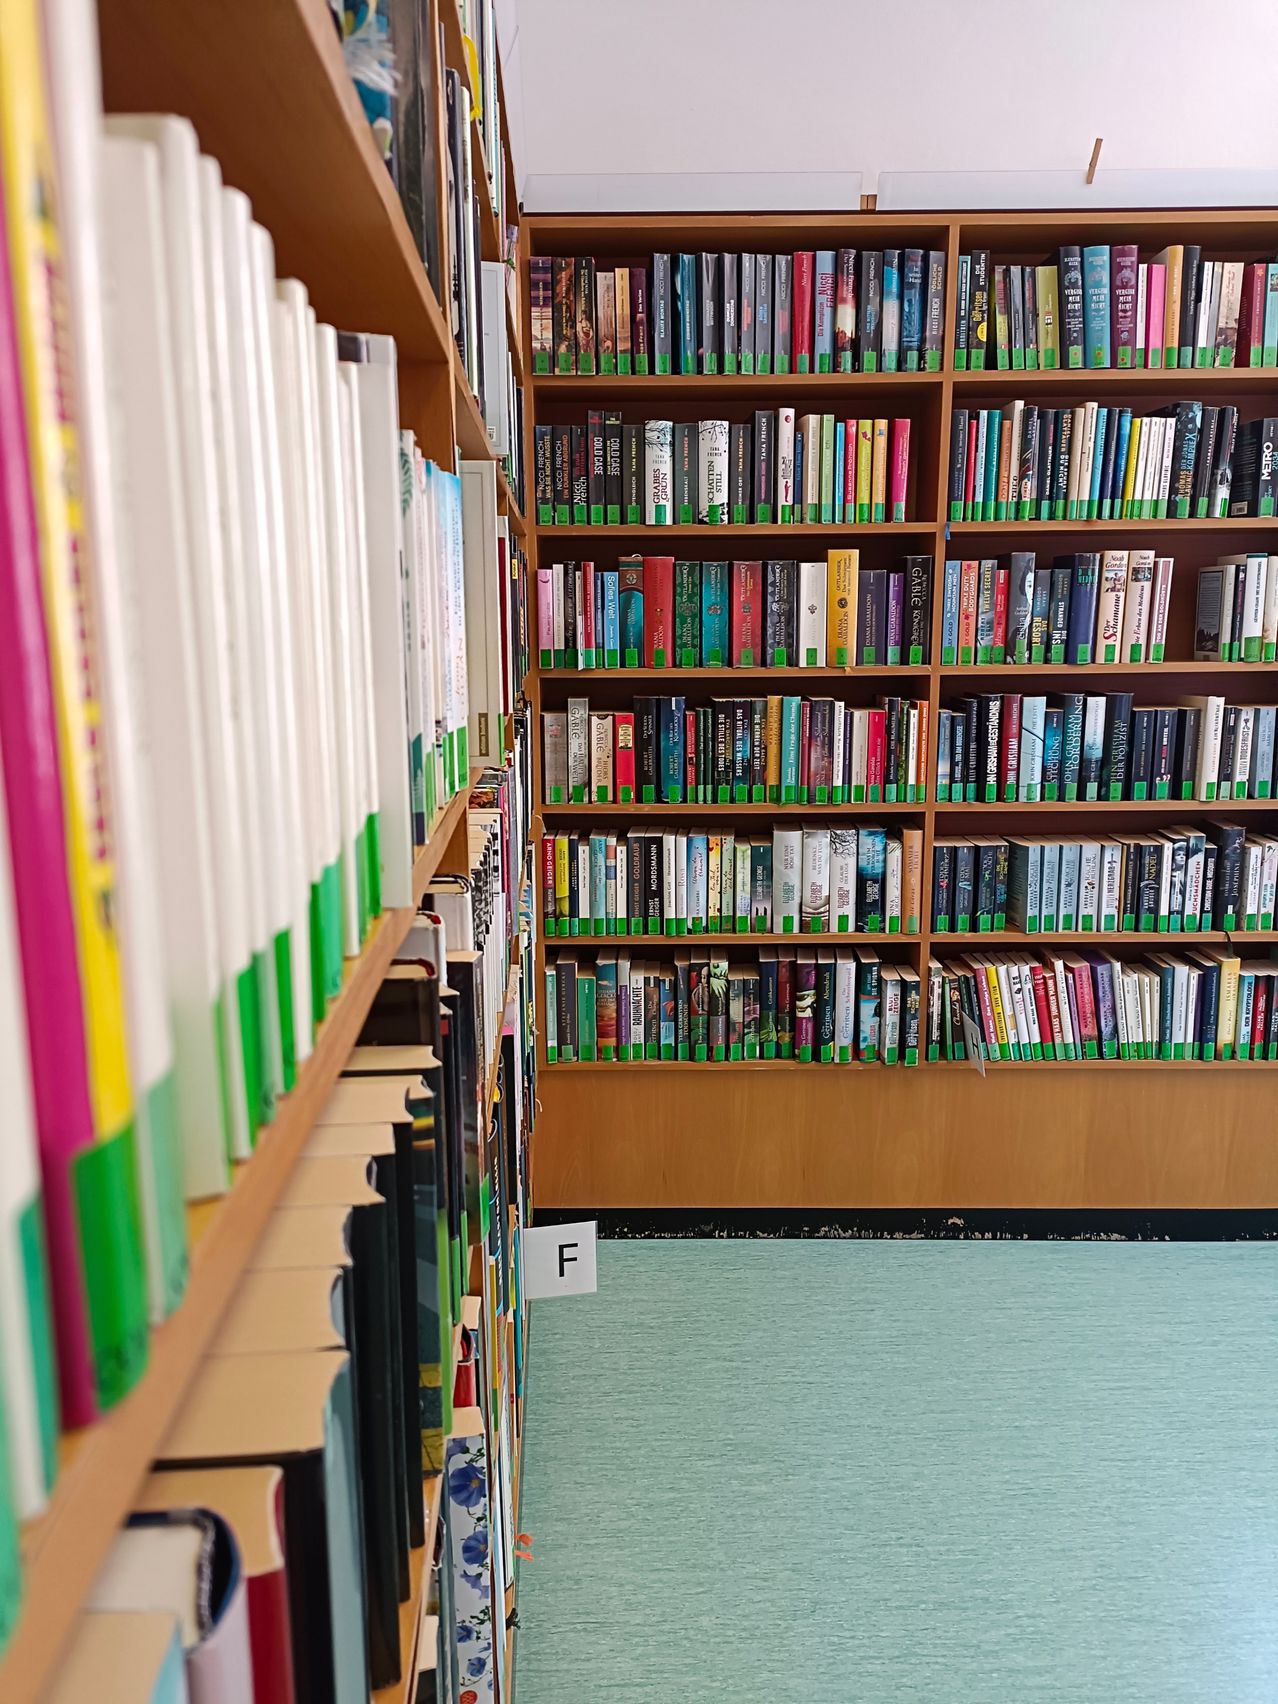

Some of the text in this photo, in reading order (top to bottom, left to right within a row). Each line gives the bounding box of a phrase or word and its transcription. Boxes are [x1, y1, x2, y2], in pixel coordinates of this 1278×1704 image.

[818, 272, 828, 296] Nicci
[537, 441, 546, 490] NICCI FRENCH
[594, 437, 603, 475] COLD CASE
[611, 438, 620, 476] COLD CASE
[1185, 432, 1197, 470] KOMPLEX
[1261, 441, 1273, 480] METRO
[573, 481, 582, 503] Nicci
[579, 476, 587, 505] French
[653, 468, 661, 504] GRABES
[707, 460, 715, 504] SCHATTEN
[1177, 470, 1186, 497] THOMAS
[967, 572, 975, 612] BODYGUARDS
[984, 564, 992, 589] SECRETS
[606, 575, 616, 619] Sofies Welt
[1137, 585, 1146, 607] Medicus
[1102, 593, 1124, 642] Schamane
[1102, 619, 1110, 633] Der
[1133, 617, 1143, 635] Erben
[971, 702, 979, 737] TOTENPFAD
[986, 700, 1000, 742] GESTÄNDNIS
[1071, 696, 1084, 769] FORDERUNG
[789, 732, 797, 750] Frage
[1008, 737, 1019, 769] GRISHAM
[1063, 714, 1074, 784] JOHN GRISHAM
[1111, 719, 1122, 761] GRISHAM
[1116, 721, 1128, 779] DER POLIZIST
[1239, 730, 1251, 761] TODESFRIST
[987, 745, 997, 773] GRISHAM
[632, 842, 641, 880] GOLDRAUB
[650, 844, 658, 891] MORDSMANN
[677, 868, 686, 887] Rosa
[1149, 854, 1157, 880] NADEL
[782, 881, 790, 904] ELIZABETH
[822, 972, 830, 1000] Abendruh
[980, 975, 988, 991] Leben
[983, 991, 991, 1006] ewige
[1244, 981, 1253, 1015] KRYPTOLOGE
[631, 986, 643, 1026] RAUHNÄCHTE
[823, 1005, 831, 1039] Gerritsen
[841, 1006, 851, 1039] Gerritsen
[951, 1001, 961, 1026] Chocolat
[557, 1243, 578, 1279] F
